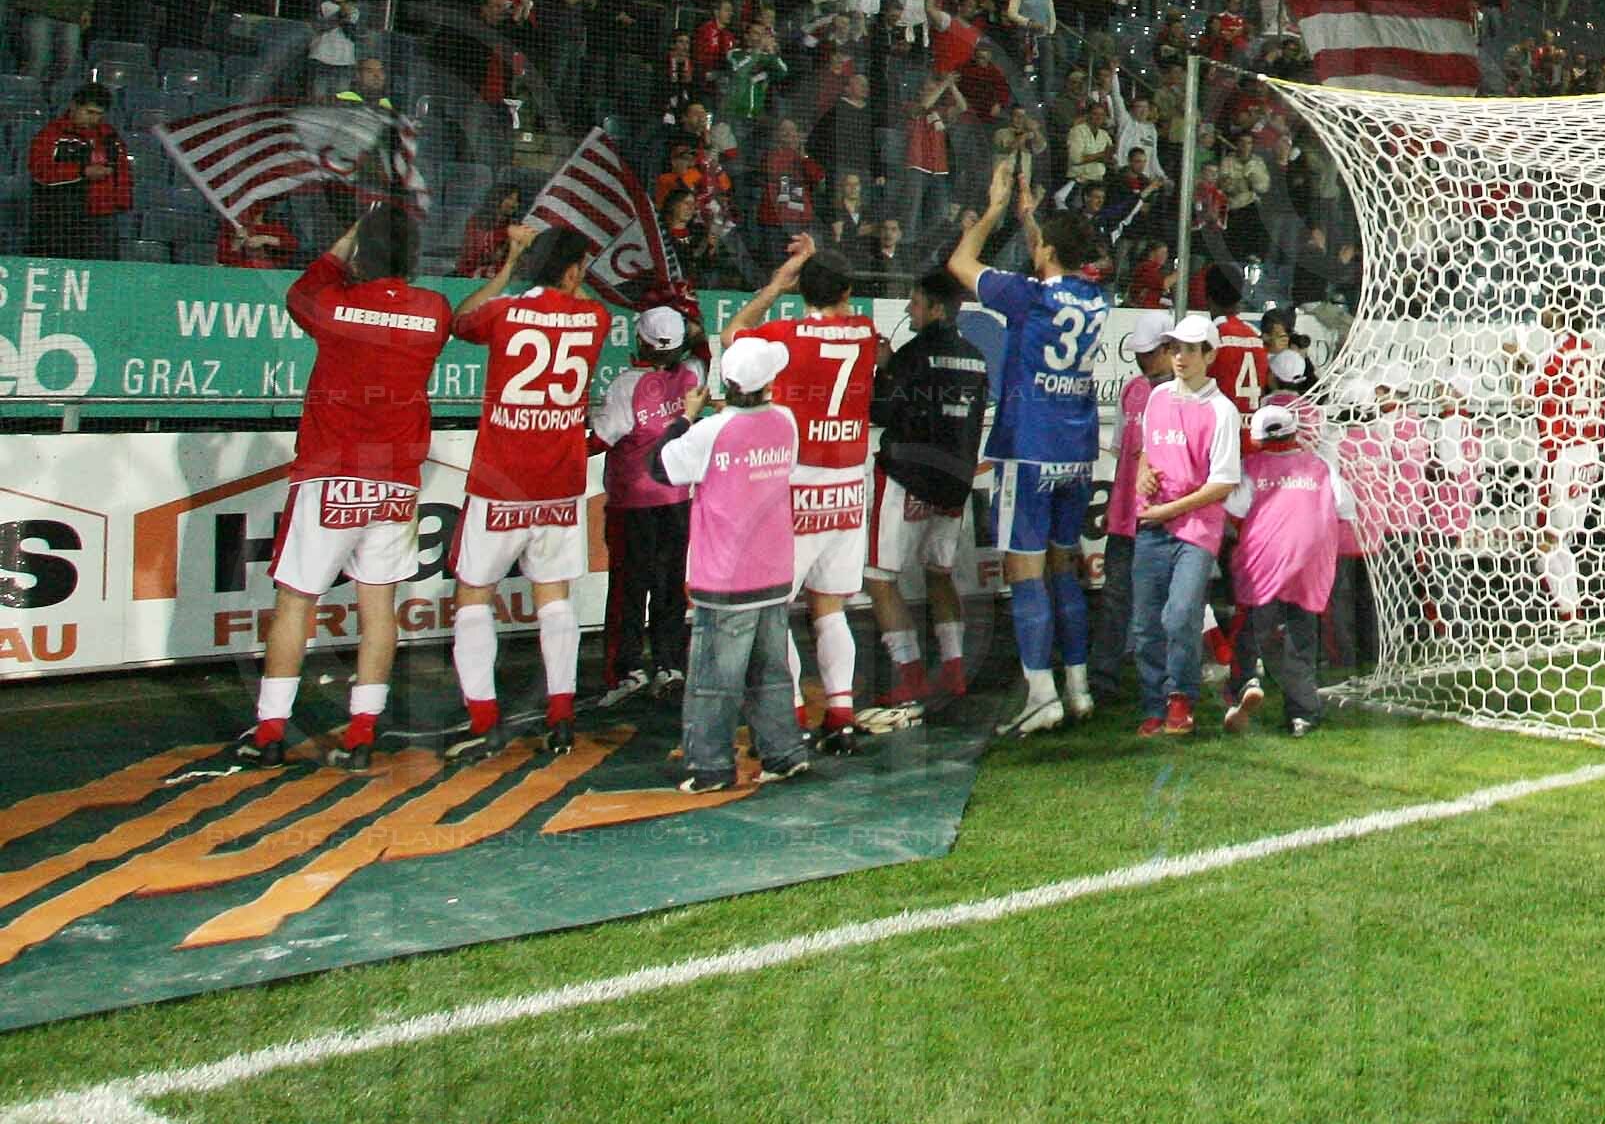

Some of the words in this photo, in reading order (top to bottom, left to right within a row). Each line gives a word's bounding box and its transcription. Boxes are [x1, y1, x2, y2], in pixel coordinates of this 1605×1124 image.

[333, 305, 437, 333] LIEBHERR
[506, 307, 599, 328] LIEBHERR
[122, 357, 222, 396] GRAZ
[500, 329, 594, 407] 25
[819, 342, 861, 417] 7
[1234, 351, 1262, 410] 4
[807, 419, 863, 443] HIDEN
